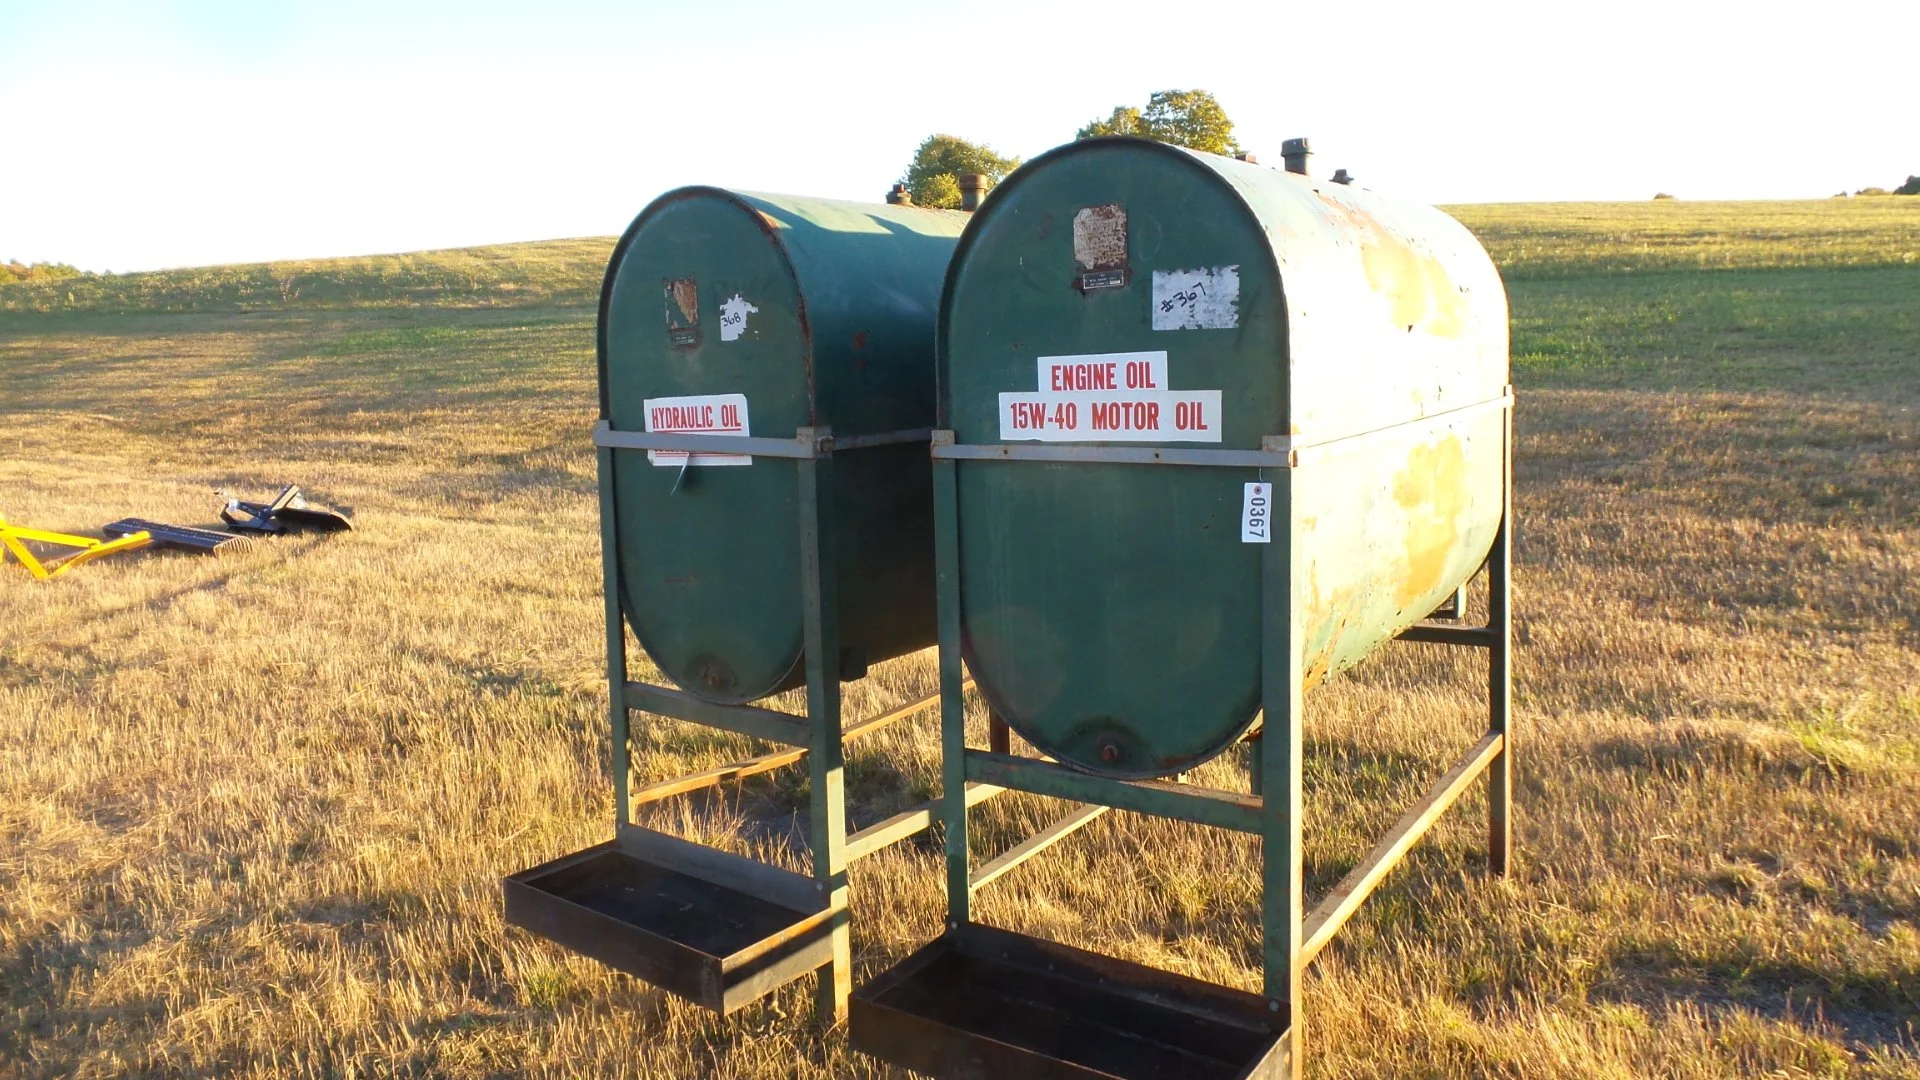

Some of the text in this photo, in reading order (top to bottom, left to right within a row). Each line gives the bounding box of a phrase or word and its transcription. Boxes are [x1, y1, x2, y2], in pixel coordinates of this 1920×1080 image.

[1051, 361, 1156, 391] ENGINE OIL
[651, 404, 741, 429] HYDRAULIC OIL
[1010, 402, 1208, 430] 15W-40 MOTOR OIL
[1249, 497, 1266, 538] 0367
